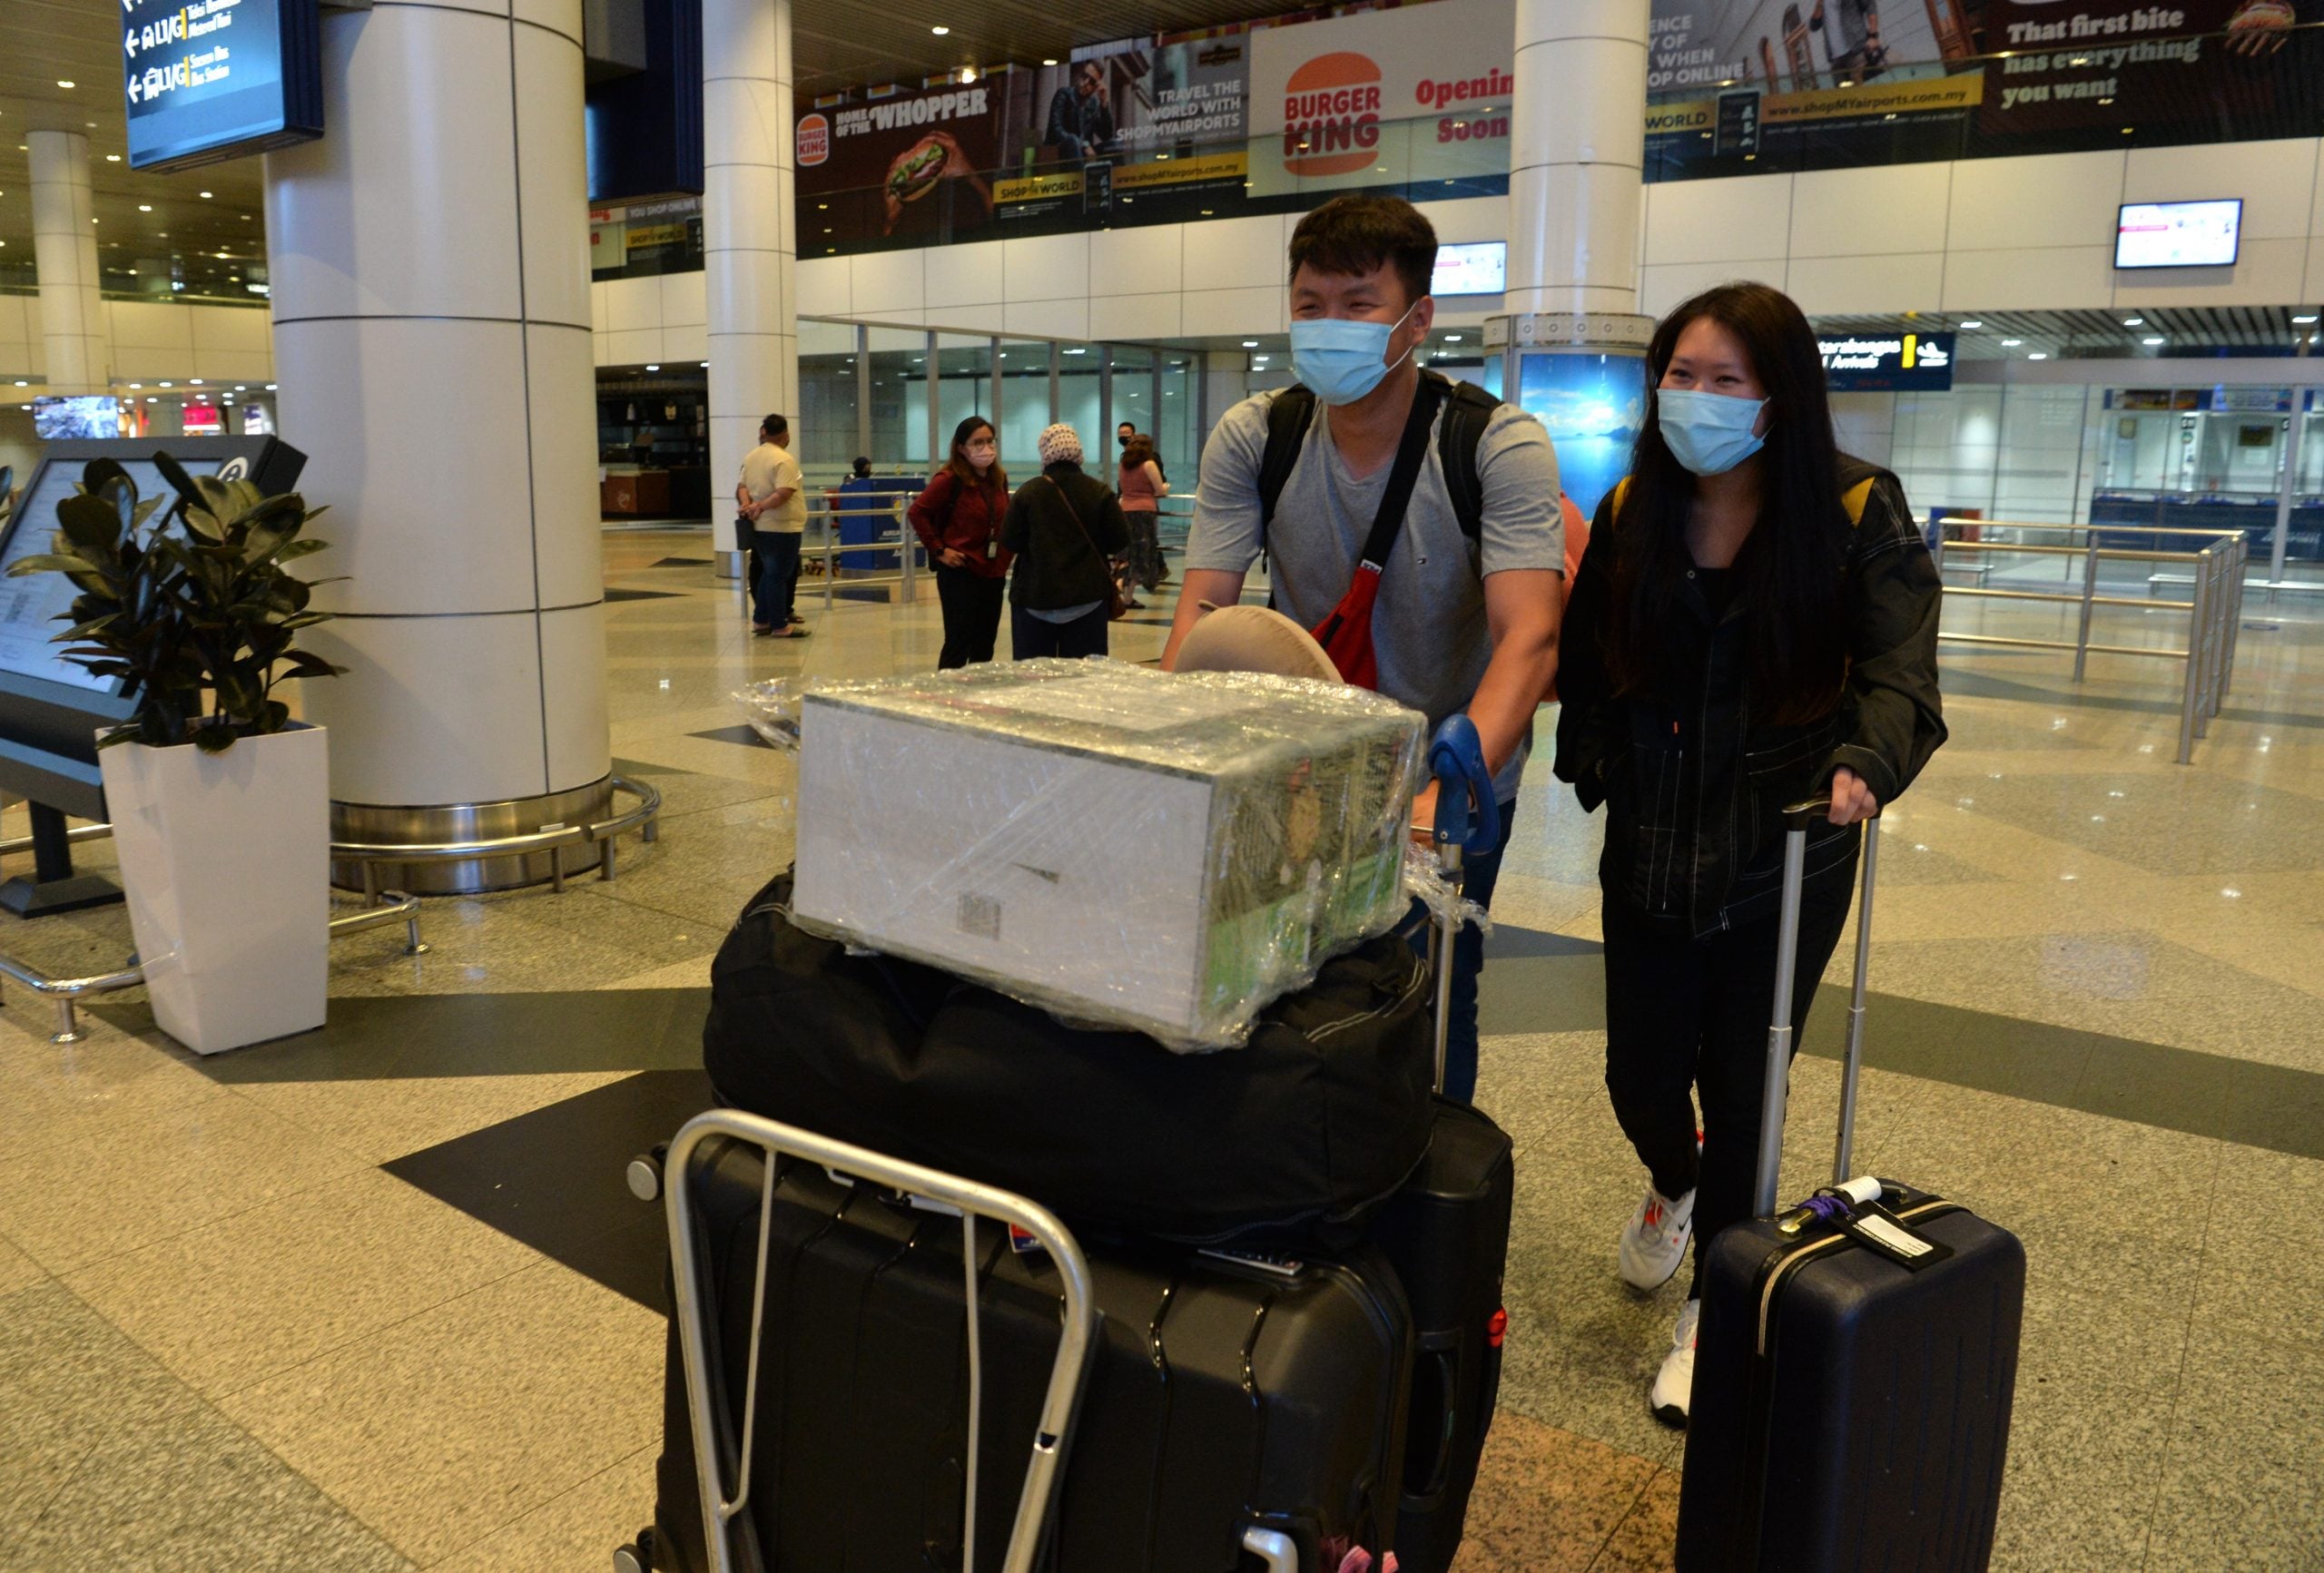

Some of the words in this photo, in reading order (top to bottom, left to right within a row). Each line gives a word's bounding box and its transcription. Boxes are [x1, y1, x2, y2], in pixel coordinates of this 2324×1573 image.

[2006, 20, 2067, 44] That
[2071, 13, 2128, 37] first
[2132, 6, 2185, 31] bite
[1662, 34, 1688, 50] OF
[1657, 47, 1715, 68] WHEN
[2004, 54, 2049, 74] has
[2053, 36, 2201, 69] everything
[1676, 63, 1744, 84] ONLINE
[1158, 84, 1209, 103] TRAVEL
[1213, 80, 1241, 96] THE
[1285, 86, 1381, 121] BURGER
[1768, 90, 1966, 116] www.shopMYairports.com.my
[2001, 84, 2050, 110] you
[2053, 77, 2118, 101] want
[835, 108, 868, 124] HOME
[869, 88, 988, 131] WHOPPER
[1147, 103, 1198, 121] WORLD
[1201, 96, 1241, 113] WITH
[1645, 112, 1708, 129] WORLD
[799, 129, 826, 141] BURGER
[835, 124, 850, 138] OF
[850, 120, 872, 135] THE
[1116, 113, 1240, 142] SHOPMYAIRPORTS
[1284, 113, 1380, 157] KING
[1437, 116, 1509, 143] Soon
[799, 140, 826, 155] KING
[1000, 187, 1027, 199] SHOP
[1039, 181, 1079, 194] WORLD
